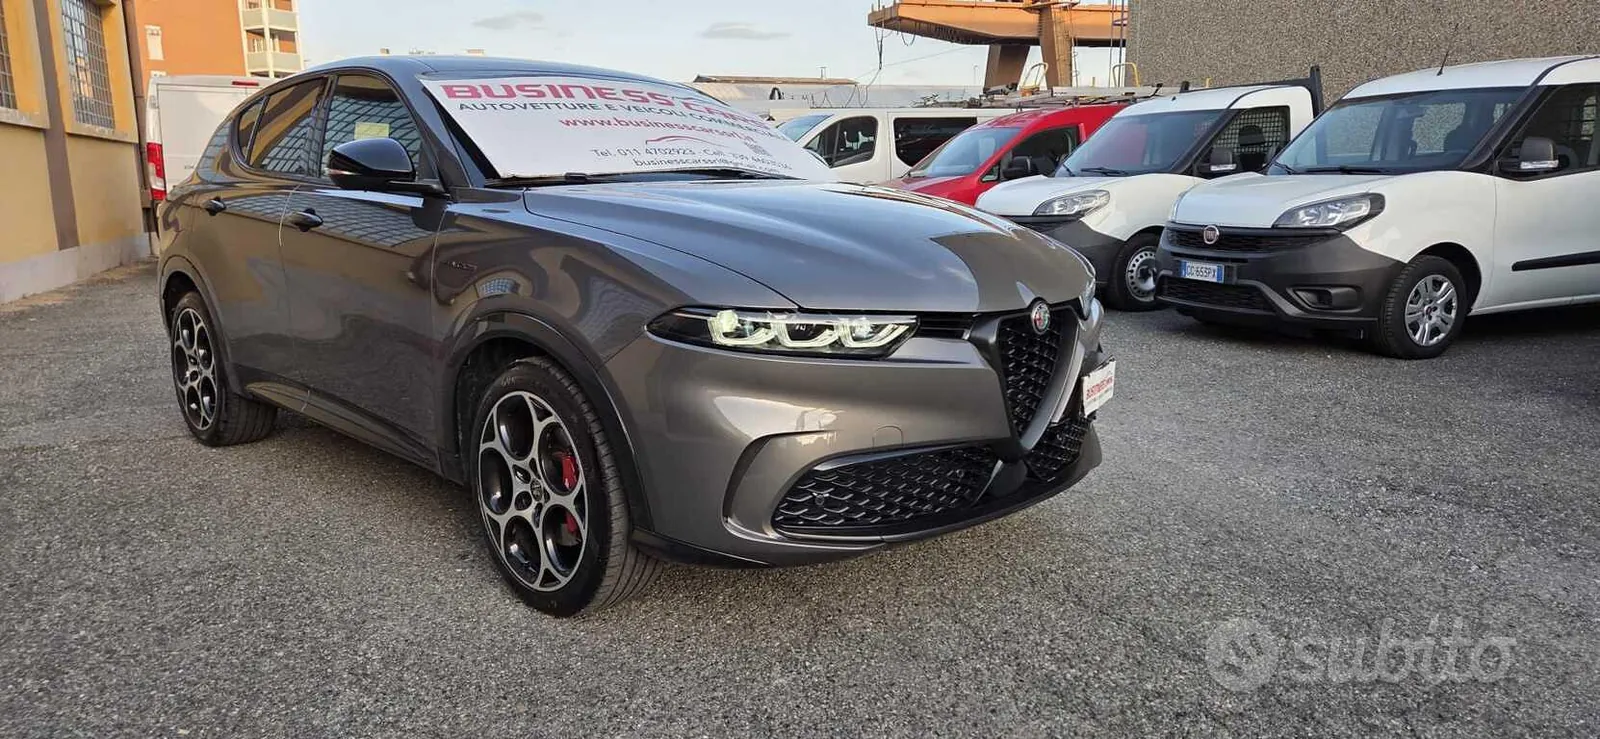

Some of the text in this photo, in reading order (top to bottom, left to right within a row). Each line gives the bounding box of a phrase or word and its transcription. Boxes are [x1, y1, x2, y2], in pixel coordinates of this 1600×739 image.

[441, 83, 675, 107] BUSINESS
[459, 101, 601, 111] AUTOVETTURE
[604, 103, 618, 111] E
[620, 104, 687, 118] VEICOLI
[591, 149, 616, 157] Tel.
[616, 148, 641, 156] 011
